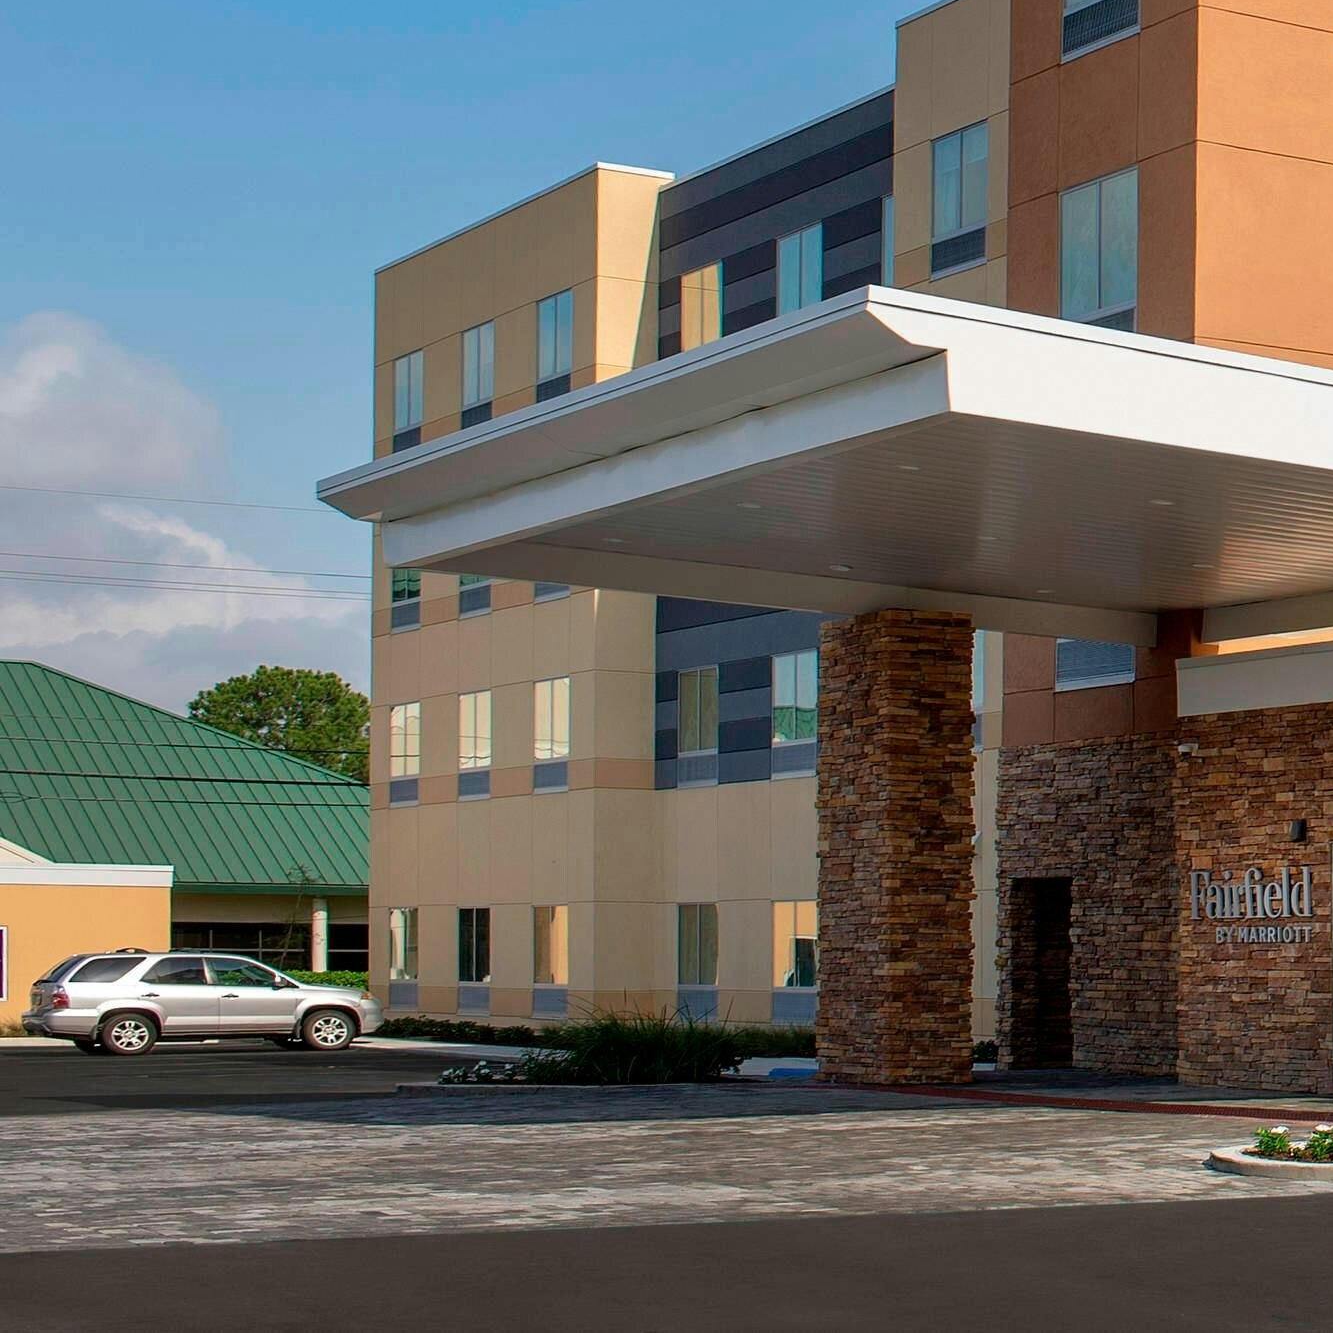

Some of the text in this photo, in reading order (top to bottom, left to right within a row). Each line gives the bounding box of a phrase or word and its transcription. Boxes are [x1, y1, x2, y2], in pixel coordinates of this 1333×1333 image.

[1188, 865, 1313, 920] Fairfield
[1215, 925, 1312, 944] BY MARRIOTT
